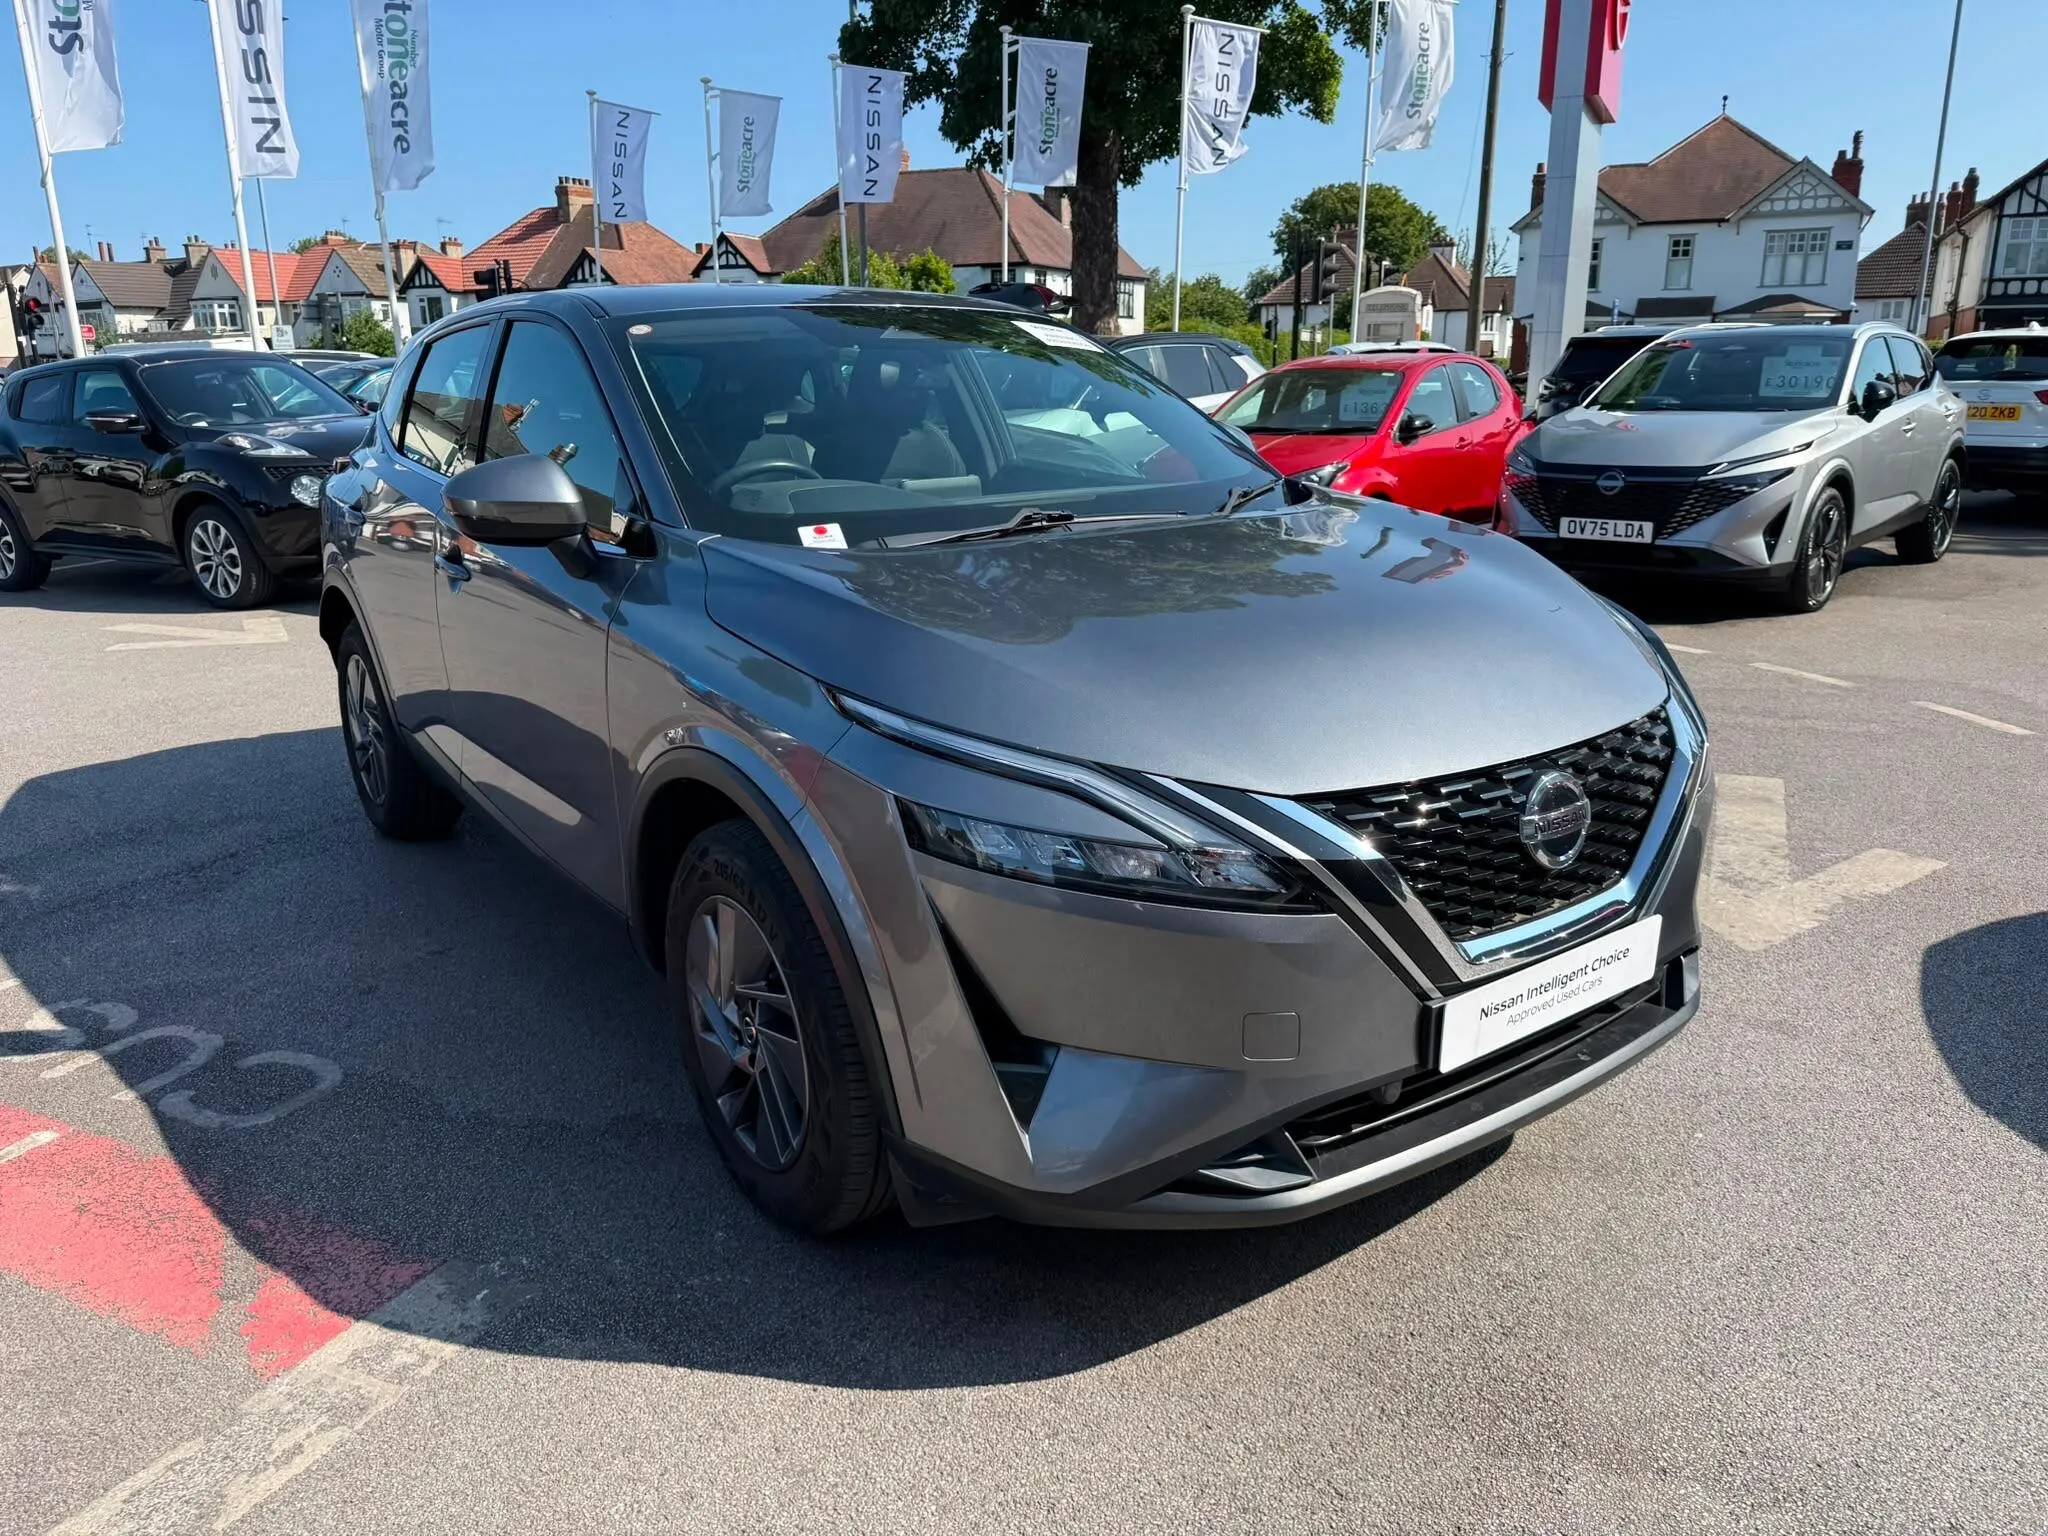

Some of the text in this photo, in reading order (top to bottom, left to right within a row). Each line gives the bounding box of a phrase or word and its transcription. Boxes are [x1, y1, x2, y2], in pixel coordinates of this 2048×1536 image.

[374, 17, 385, 79] Motor Group
[383, 0, 412, 155] toneacre
[1406, 22, 1430, 120] Stoneacre
[863, 75, 882, 197] NISSAN
[1039, 67, 1058, 155] Stoneacre
[1211, 33, 1235, 166] NISSAN
[611, 110, 630, 218] NISSAN
[736, 115, 755, 193] Stoneacre
[1990, 407, 2016, 418] ZKB
[1567, 520, 1645, 539] OV75 LDA
[1534, 808, 1586, 835] NISSAN
[1479, 947, 1630, 1021] Nissan Intelligent Choice
[1506, 975, 1603, 1026] Approved Used Cars
